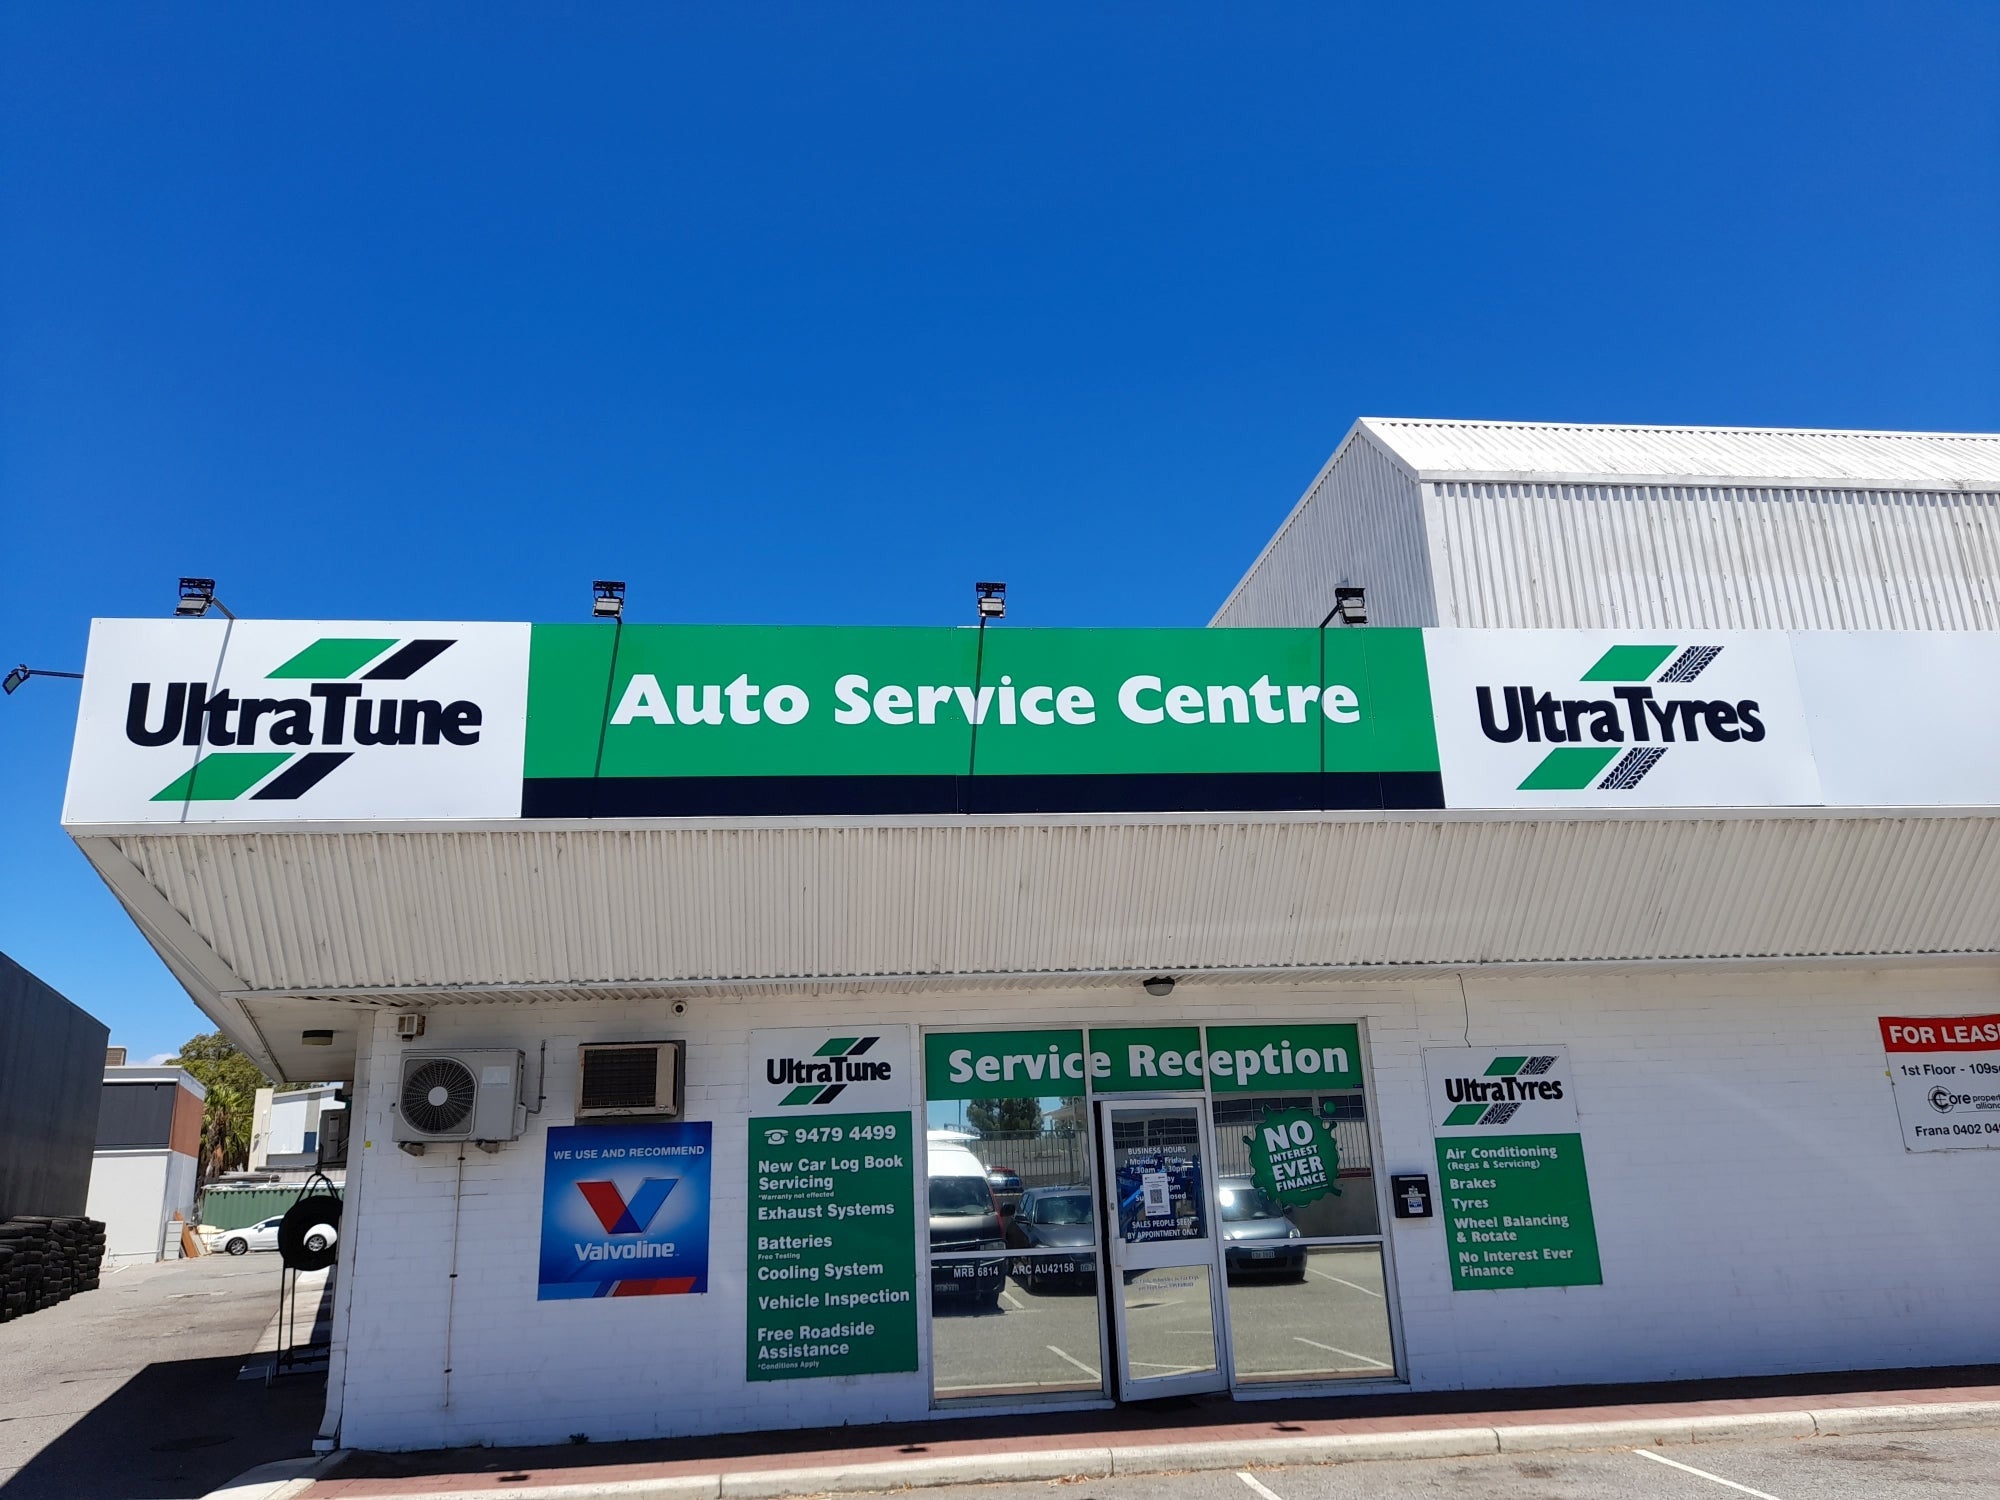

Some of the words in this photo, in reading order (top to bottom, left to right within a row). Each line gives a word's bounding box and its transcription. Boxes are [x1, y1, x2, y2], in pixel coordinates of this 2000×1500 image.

[610, 673, 810, 726] Auto
[834, 674, 1096, 726] Service
[1118, 674, 1361, 725] Centre
[126, 682, 481, 747] UltraTune
[1476, 686, 1765, 743] UltraTyres
[1889, 1026, 1936, 1044] FOR
[1941, 1023, 2000, 1043] LEAS
[767, 1056, 891, 1084] UltraTune
[949, 1044, 1111, 1084] Service
[1128, 1040, 1349, 1086] Reception
[1901, 1065, 1920, 1076] 1st
[1923, 1064, 1956, 1075] Floor
[1969, 1063, 2000, 1075] 109s
[1445, 1076, 1563, 1102] UltraTyres
[795, 1127, 843, 1143] 9479
[849, 1125, 896, 1140] 4499
[1263, 1120, 1313, 1152] NO
[1915, 1126, 1950, 1137] Frana
[1953, 1125, 1982, 1135] 0402
[1985, 1123, 2000, 1134] 04
[553, 1150, 572, 1160] WE
[575, 1149, 598, 1159] USE
[601, 1149, 626, 1158] AND
[629, 1146, 705, 1157] RECOMMEND
[1163, 1146, 1187, 1154] HOURS
[1269, 1145, 1318, 1163] INTEREST
[1446, 1148, 1466, 1160] Air
[1471, 1145, 1558, 1159] Conditioning
[758, 1160, 793, 1173] New
[798, 1158, 826, 1172] Car
[831, 1157, 859, 1172] Log
[865, 1154, 903, 1169] Book
[1129, 1156, 1158, 1166] Monday
[1164, 1156, 1186, 1165] Friday
[1272, 1156, 1324, 1181] EVER
[1447, 1161, 1480, 1172] (Regas
[1483, 1161, 1491, 1169] &
[1493, 1159, 1541, 1170] Servicing)
[759, 1174, 834, 1191] Servicing
[1276, 1172, 1327, 1192] FINANCE
[1450, 1178, 1497, 1190] Brakes
[758, 1206, 823, 1221] Exhaust
[827, 1203, 895, 1220] Systems
[1451, 1198, 1489, 1212] Tyres
[1152, 1219, 1175, 1227] PEOPLE
[1176, 1218, 1192, 1226] SEEN
[1454, 1216, 1498, 1229] Wheel
[1503, 1214, 1570, 1229] Balancing
[758, 1235, 833, 1250] Batteries
[1127, 1232, 1137, 1240] BY
[1138, 1230, 1181, 1239] APPOINTMENT
[1182, 1228, 1198, 1236] ONLY
[1456, 1231, 1467, 1243] &
[1472, 1229, 1517, 1243] Rotate
[575, 1240, 675, 1261] Valvoline
[1459, 1251, 1479, 1263] No
[1484, 1249, 1539, 1262] Interest
[1543, 1248, 1573, 1260] Ever
[758, 1265, 819, 1281] Cooling
[824, 1262, 884, 1280] System
[954, 1268, 975, 1278] MRB
[977, 1267, 999, 1278] 6814
[1012, 1264, 1032, 1275] ARC
[1035, 1262, 1075, 1274] AU42158
[1461, 1264, 1515, 1277] Finance
[758, 1294, 820, 1310] Vehicle
[825, 1289, 910, 1308] Inspection
[758, 1328, 794, 1342] Free
[800, 1322, 875, 1340] Roadside
[758, 1343, 850, 1360] Assistance
[800, 1360, 820, 1369] Apply
